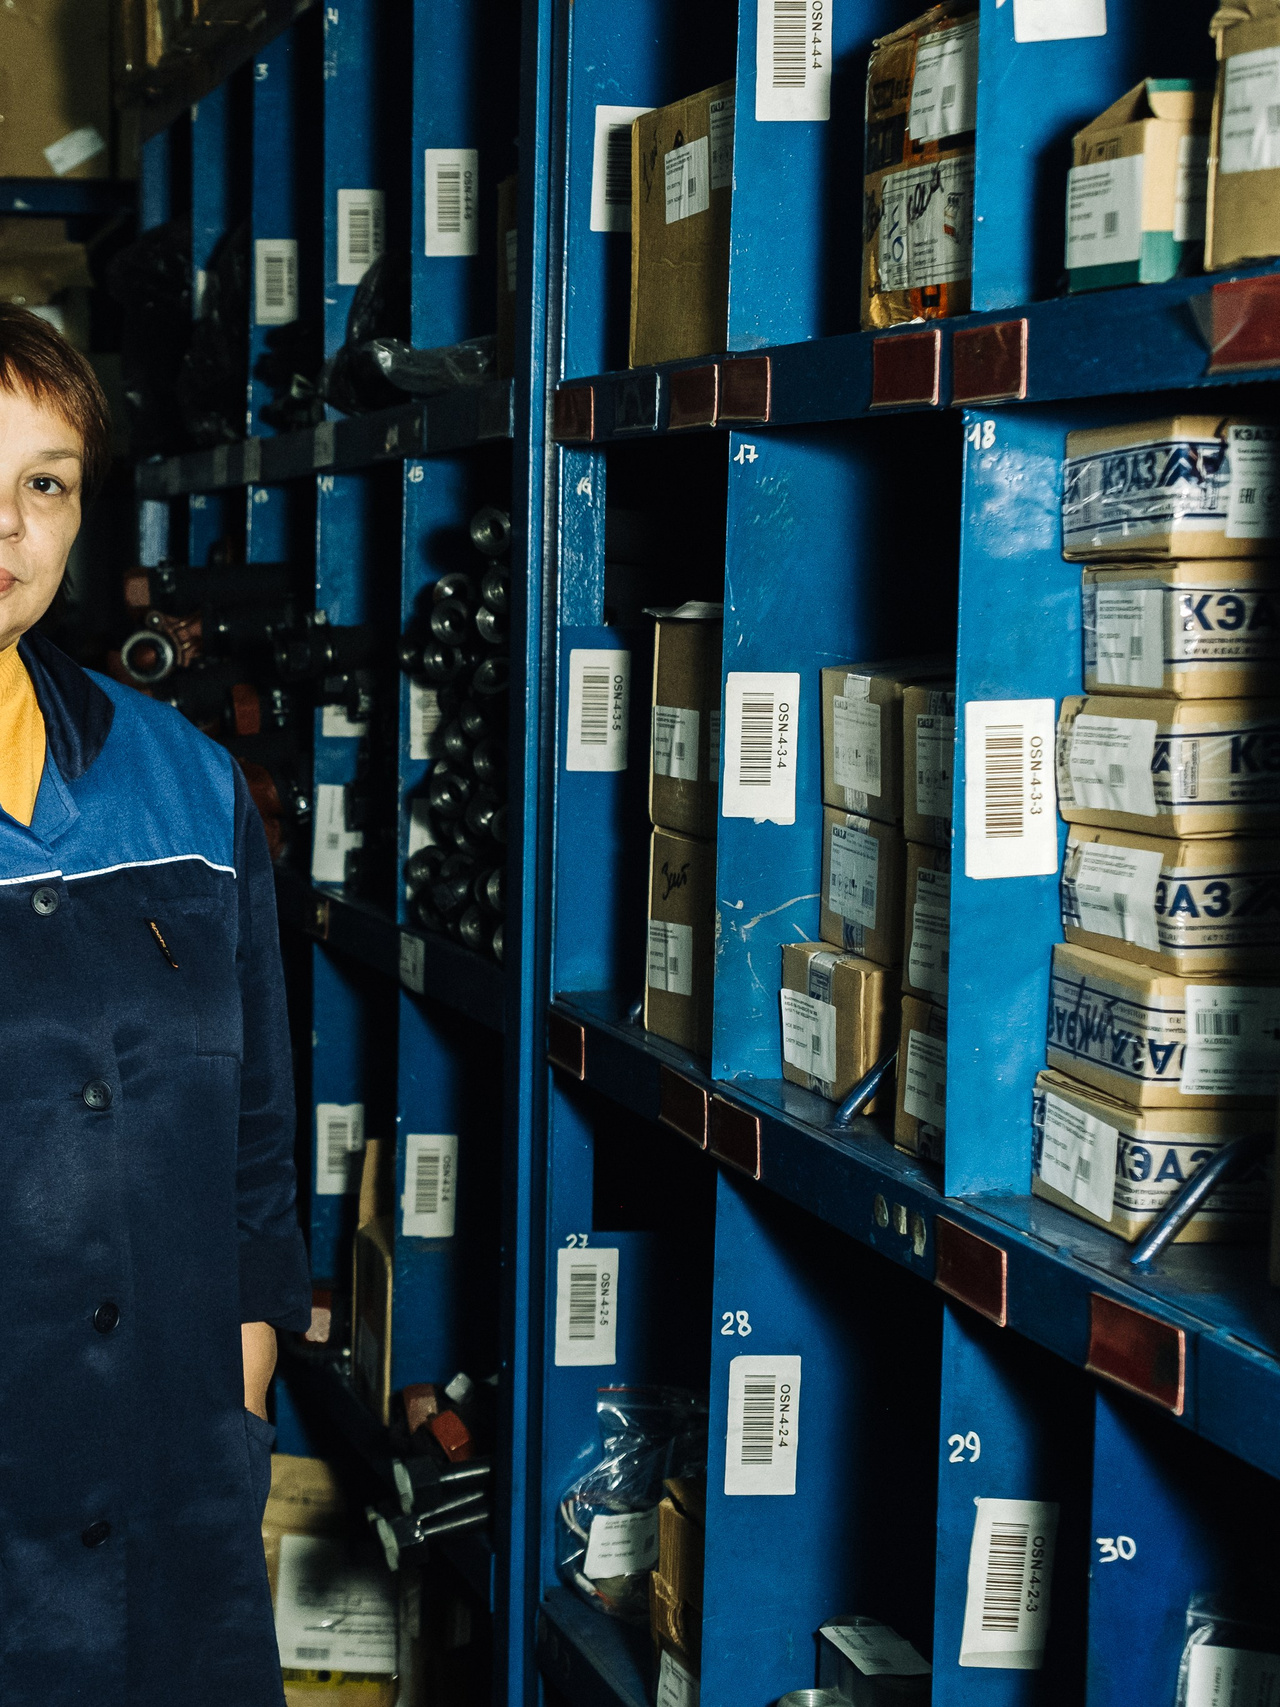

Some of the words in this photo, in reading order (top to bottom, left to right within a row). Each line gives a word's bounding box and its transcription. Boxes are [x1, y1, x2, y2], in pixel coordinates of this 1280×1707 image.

[811, 0, 822, 69] OSN-4-4-4
[733, 443, 759, 466] 17
[966, 419, 996, 449] 18
[406, 466, 425, 484] 15
[612, 674, 624, 731] OSN-4-3-5
[777, 702, 790, 769] OSN-4-3-4
[1030, 736, 1042, 815] OSN-4-3-3
[565, 1233, 589, 1249] 27
[600, 1272, 611, 1326] OSN-4-2-5
[720, 1310, 752, 1337] 28
[778, 1384, 791, 1448] OSN-4-2-4
[947, 1430, 981, 1463] 29
[1097, 1536, 1137, 1563] 30
[1025, 1535, 1046, 1613] OSN-4-2-3
